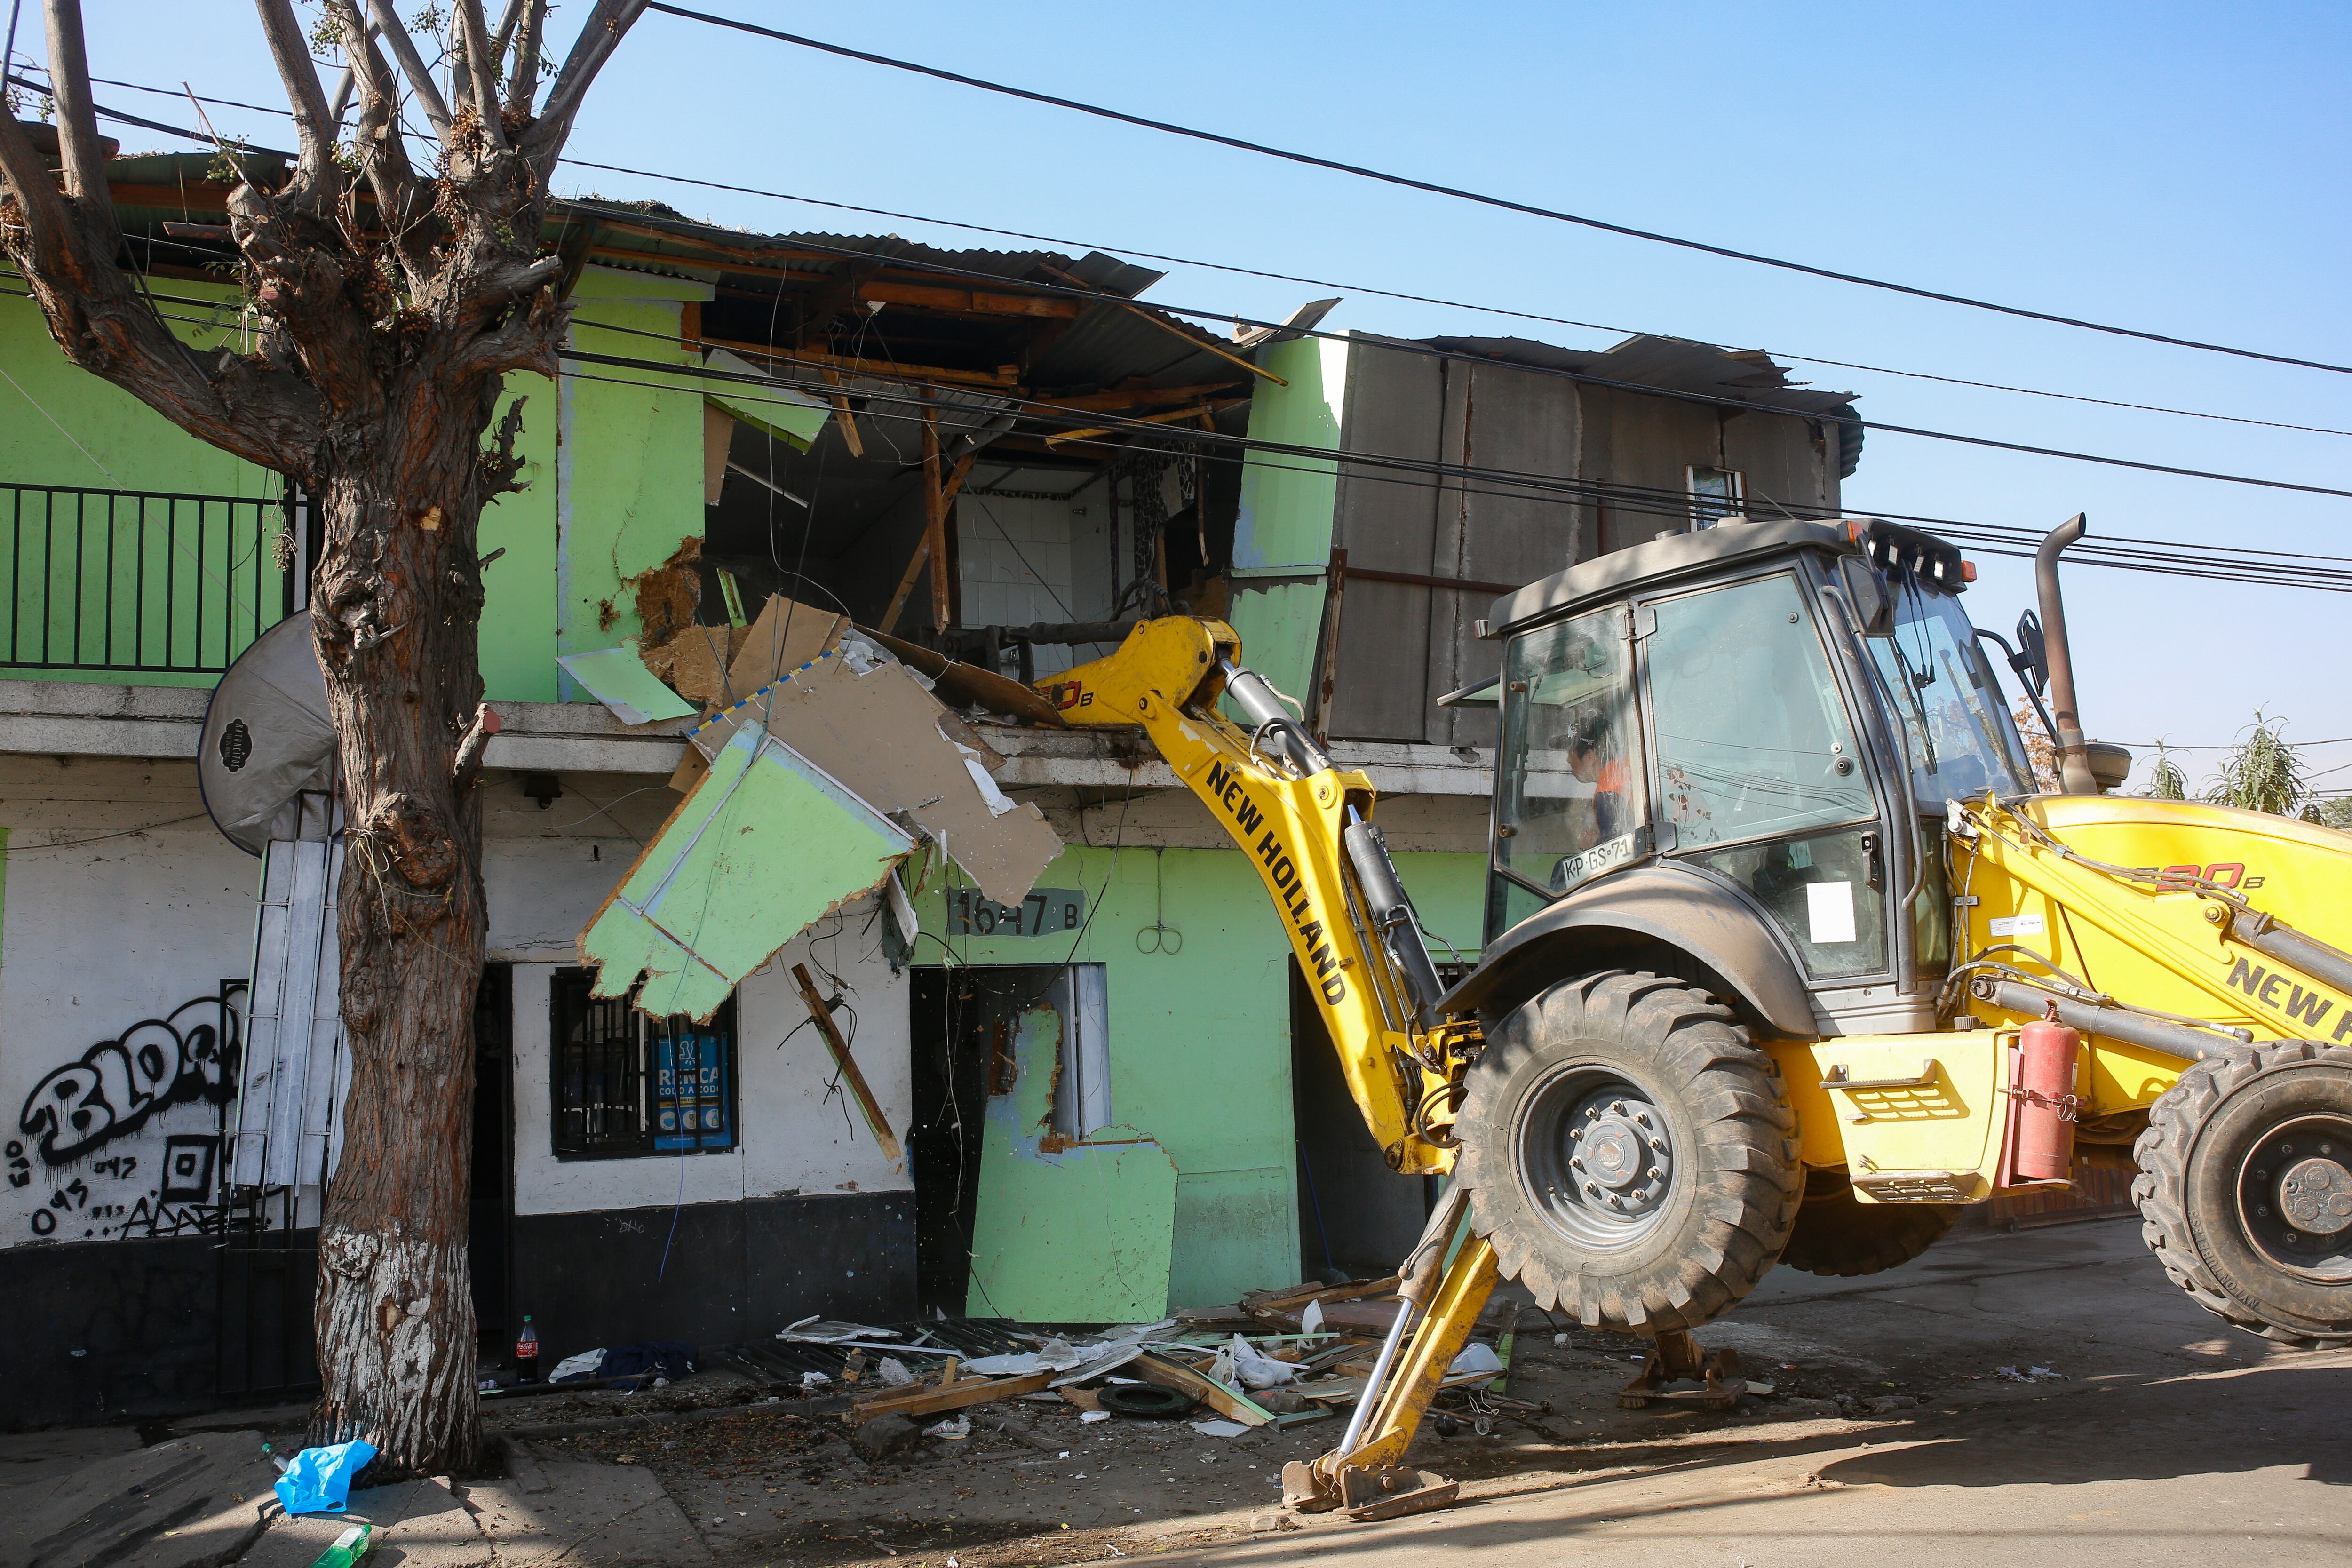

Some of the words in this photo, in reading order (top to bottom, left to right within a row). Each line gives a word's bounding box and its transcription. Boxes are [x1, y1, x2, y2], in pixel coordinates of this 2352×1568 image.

[231, 724, 243, 767] RATONCITOS
[1206, 760, 1265, 836] NEW
[1256, 836, 1347, 1006] HOLLAND
[958, 893, 1047, 935] 1647
[1064, 903, 1078, 929] B
[2226, 957, 2334, 1027] NEW
[2190, 1210, 2223, 1276] TUBELESS
[2220, 1274, 2260, 1309] NYLON
